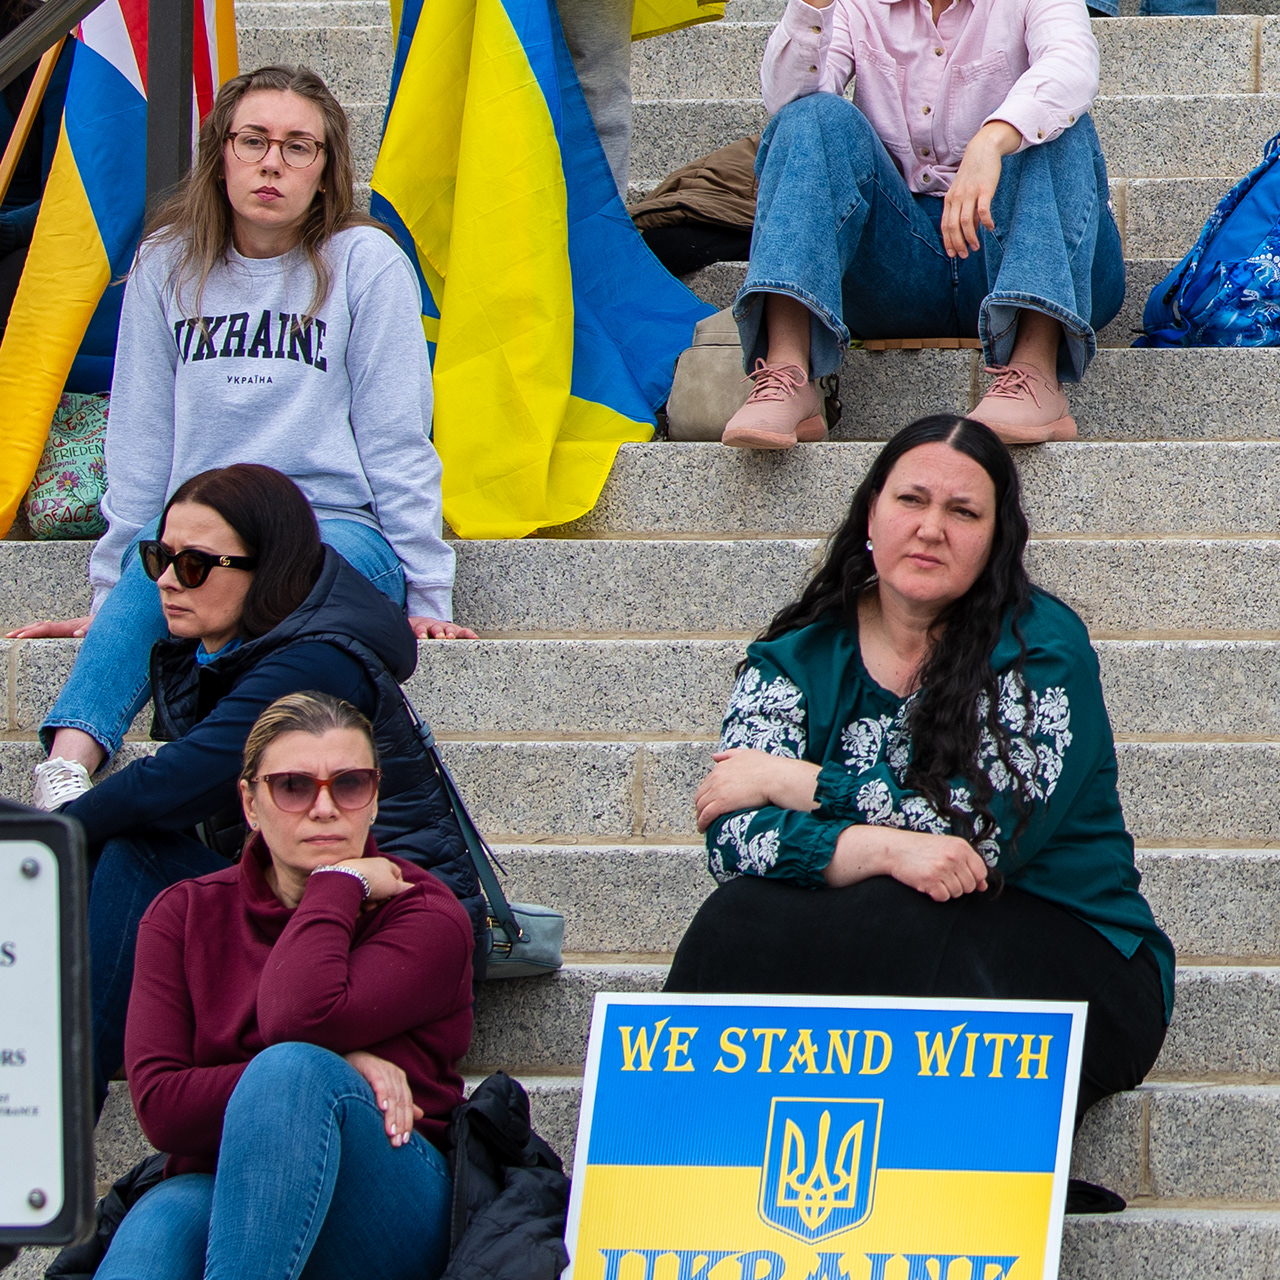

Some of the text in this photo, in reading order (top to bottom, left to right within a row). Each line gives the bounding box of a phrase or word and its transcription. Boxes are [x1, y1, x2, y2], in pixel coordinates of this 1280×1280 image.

[174, 310, 328, 373] UKRAINE
[226, 374, 273, 384] УКРАЇНА
[53, 444, 105, 463] FRIEDEN
[618, 1015, 1054, 1079] WE STAND WITH
